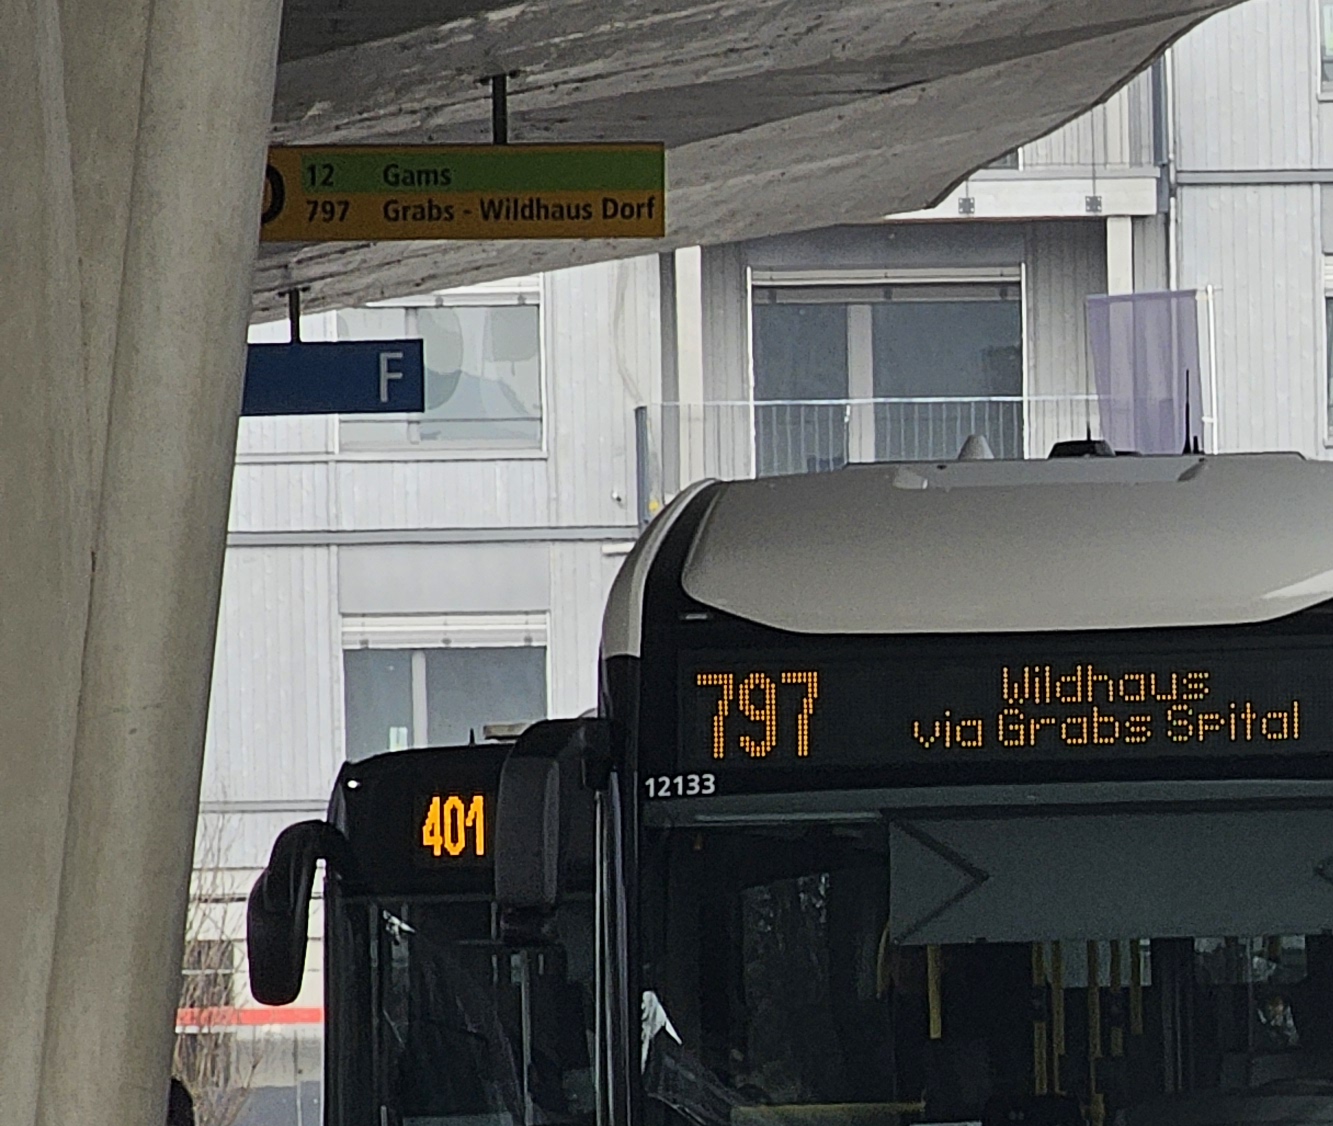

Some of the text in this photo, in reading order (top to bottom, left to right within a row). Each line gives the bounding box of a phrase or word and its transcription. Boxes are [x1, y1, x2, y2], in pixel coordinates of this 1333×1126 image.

[306, 162, 452, 189] 12 Gams
[306, 198, 351, 224] 797
[382, 197, 455, 224] Grabs
[480, 195, 594, 223] Wildhaus
[601, 194, 656, 222] Dorf
[379, 351, 404, 404] F
[1003, 665, 1210, 705] Wildhaus
[697, 671, 819, 760] 797
[913, 700, 1300, 749] via Grabs Spital
[645, 774, 715, 798] 12133
[422, 795, 485, 858] 401
